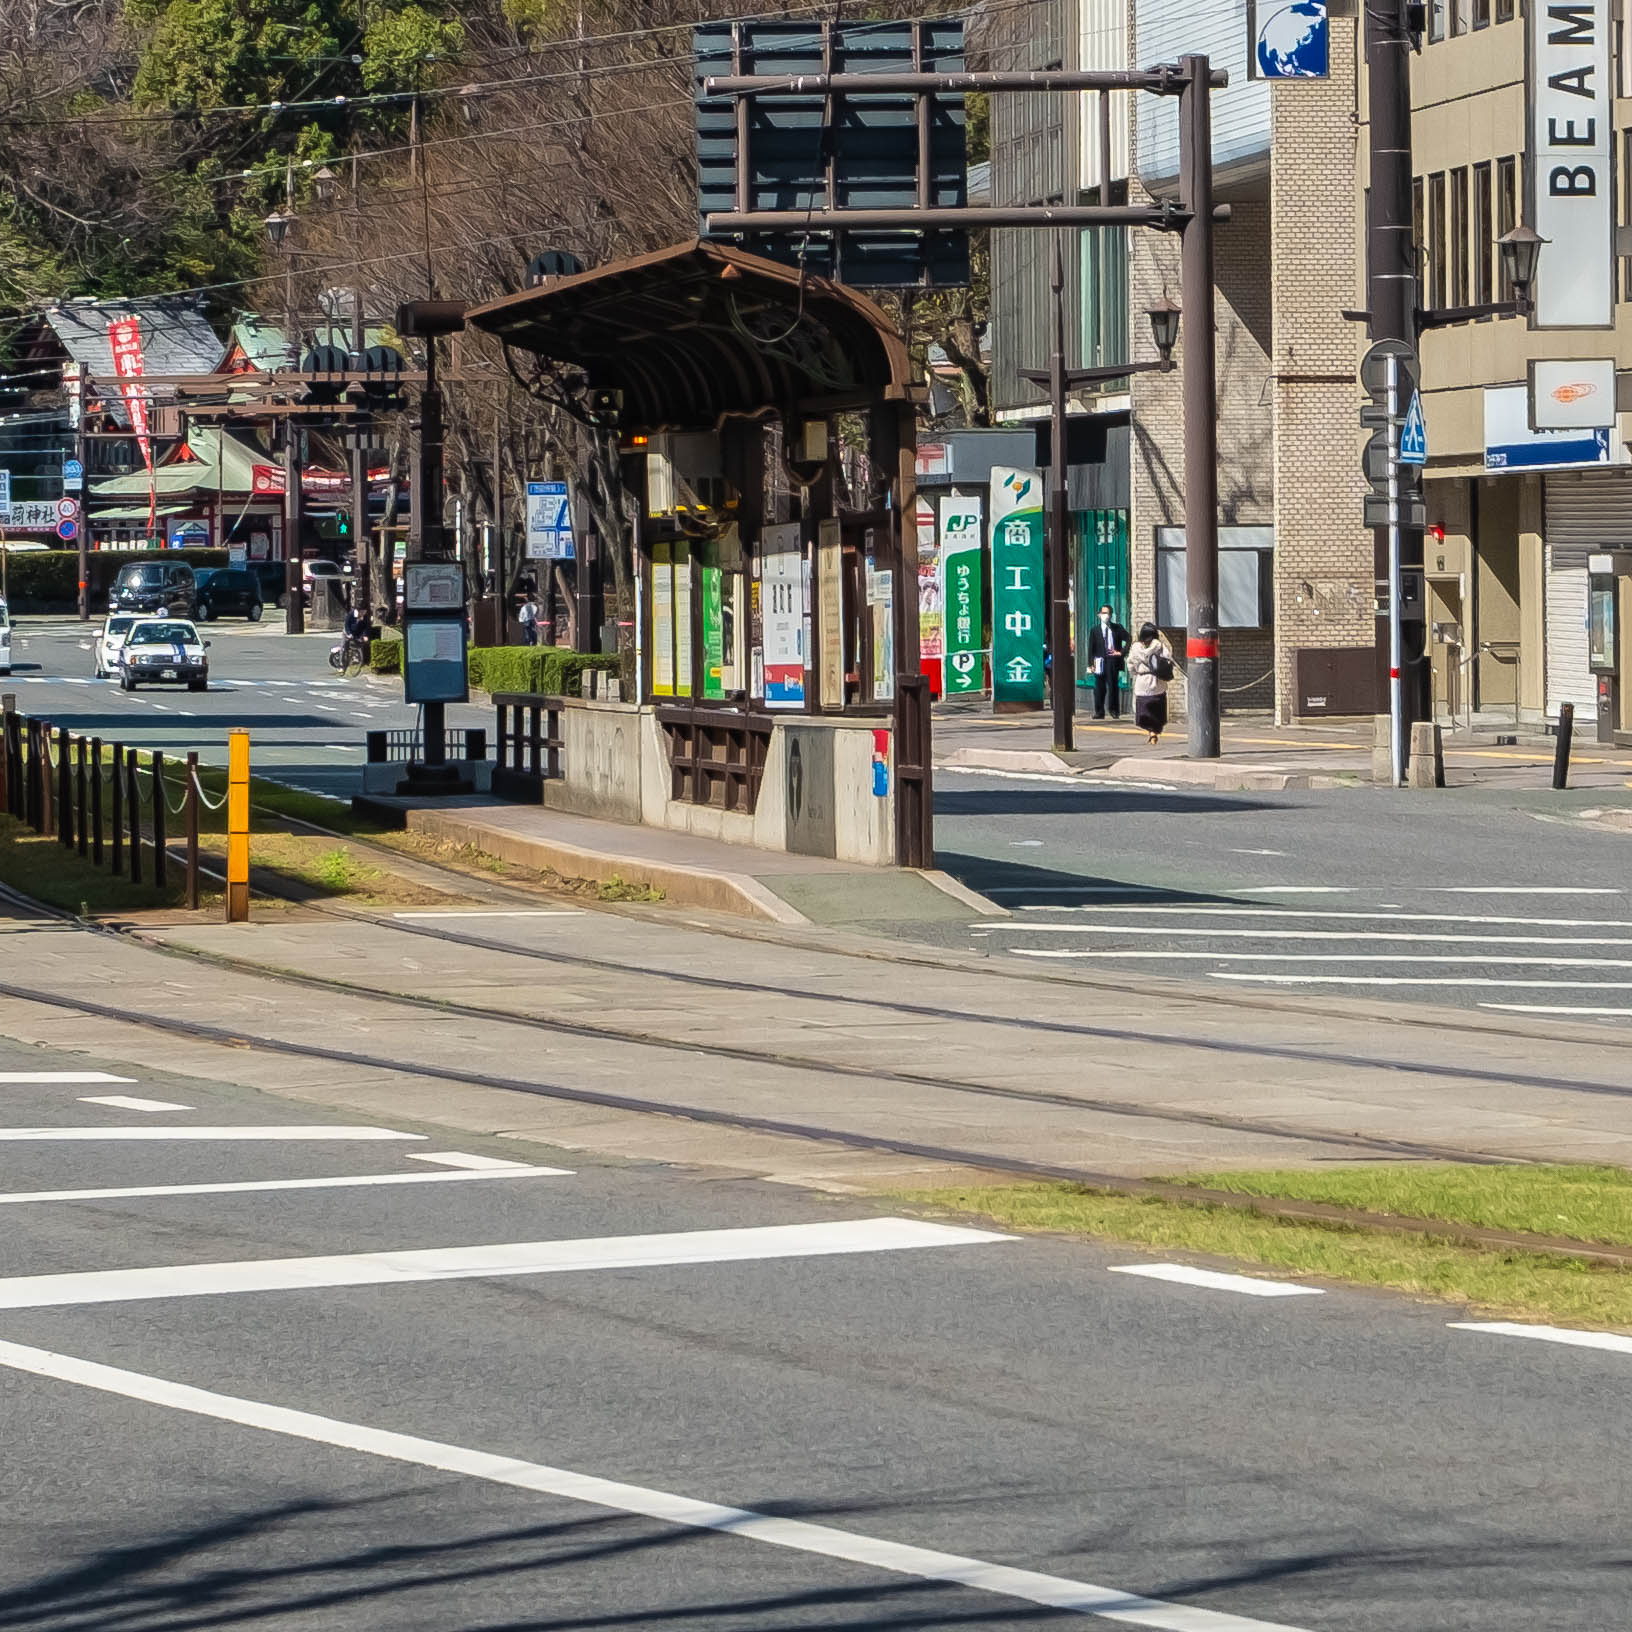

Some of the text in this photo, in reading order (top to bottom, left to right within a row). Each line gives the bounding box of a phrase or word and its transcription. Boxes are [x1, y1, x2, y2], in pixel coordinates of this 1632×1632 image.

[956, 564, 971, 644] ゆうちょ銀行
[1004, 519, 1033, 683] 商工中金
